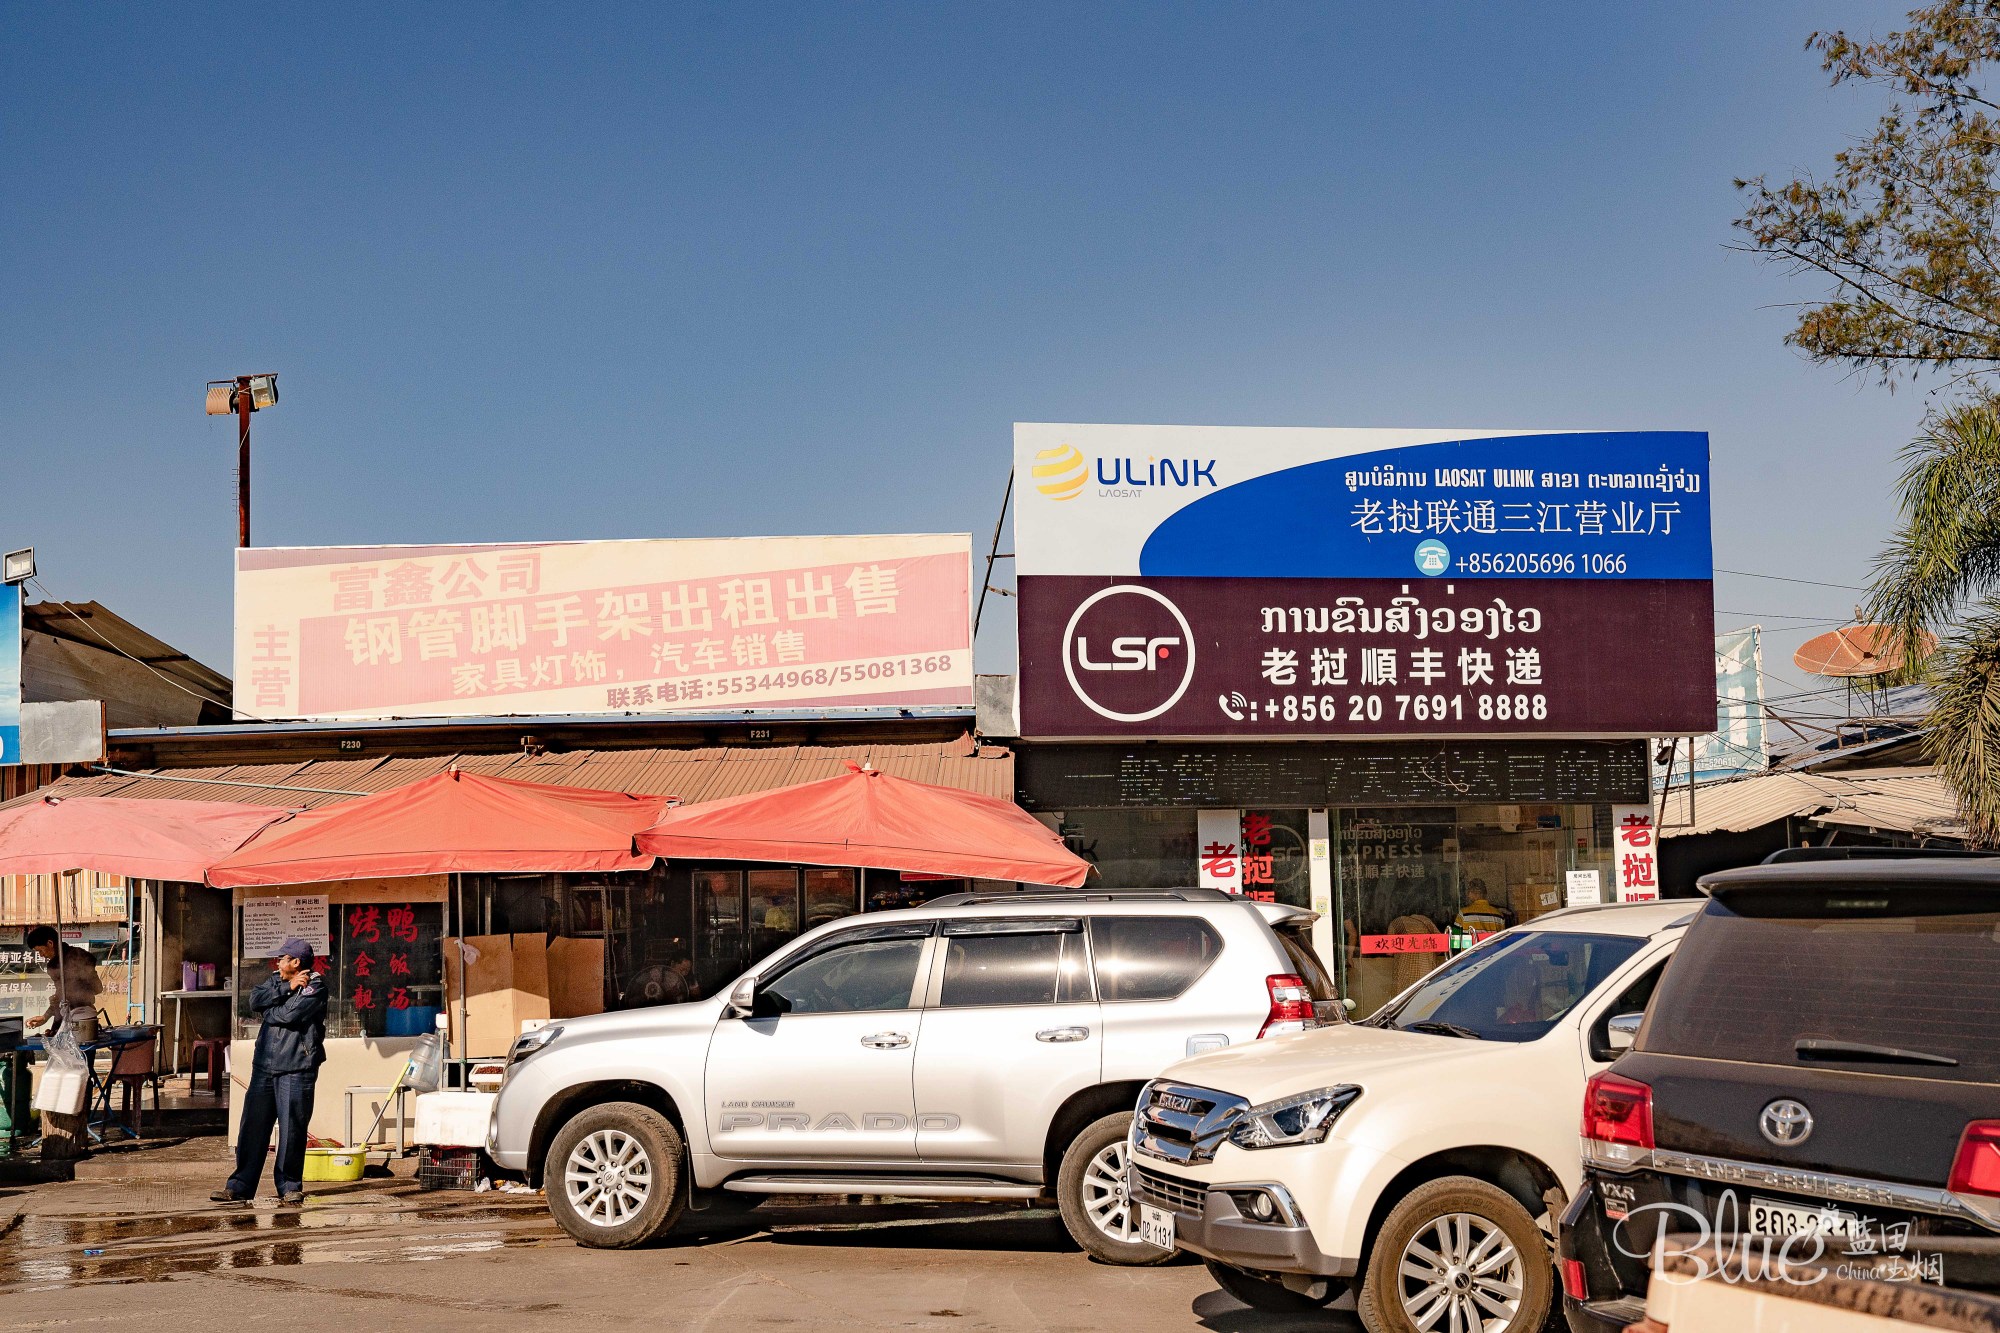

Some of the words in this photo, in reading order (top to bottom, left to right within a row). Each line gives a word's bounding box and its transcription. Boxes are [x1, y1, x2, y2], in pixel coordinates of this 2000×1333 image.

[1435, 469, 1486, 488] LAOSAT
[1494, 469, 1535, 488] ULINK
[1098, 489, 1143, 498] LAOSAT
[1350, 498, 1682, 536] 老挝联通三江营业厅
[1582, 553, 1627, 574] 1066
[330, 553, 541, 612] 富鑫公司
[344, 564, 900, 667] 钢管脚手架出租出售
[251, 624, 292, 708] 主营
[1349, 695, 1383, 721] 20
[1395, 695, 1463, 721] 7691
[1478, 694, 1548, 721] 8888
[340, 739, 362, 750] F230
[750, 730, 771, 739] F231
[1347, 844, 1423, 860] XPRESS
[1202, 841, 1238, 894] 老
[349, 903, 419, 944] 烤鸭
[353, 951, 411, 978] 盒饭
[721, 1100, 748, 1108] LAND
[751, 1100, 795, 1108] CRUISER
[719, 1113, 960, 1132] PRADO
[1600, 1182, 1636, 1201] VXR
[1153, 1225, 1172, 1248] 1131
